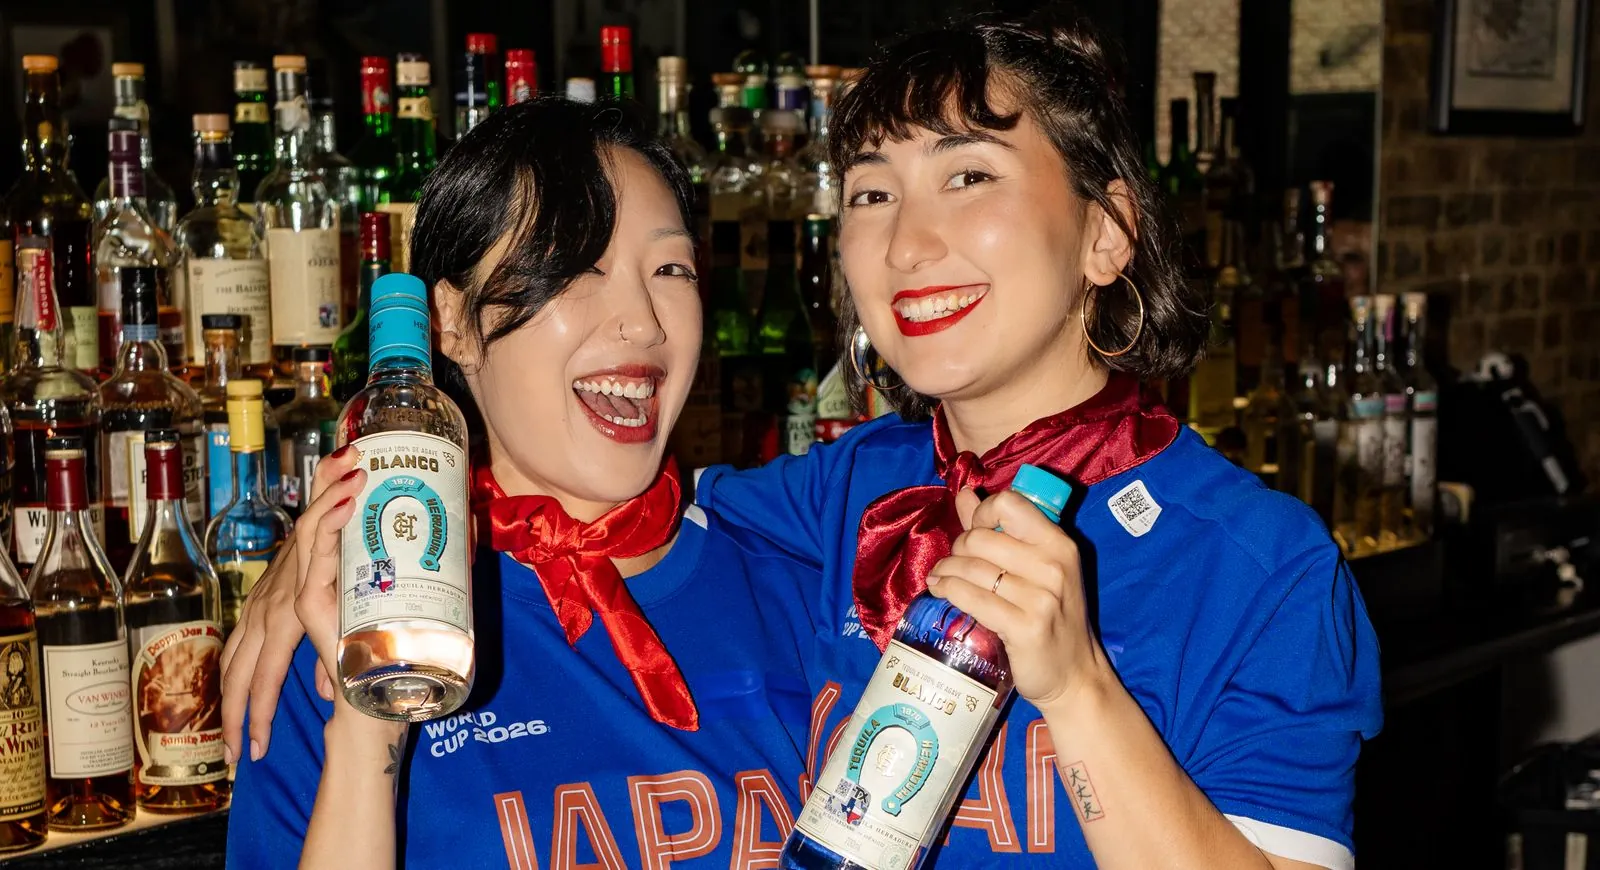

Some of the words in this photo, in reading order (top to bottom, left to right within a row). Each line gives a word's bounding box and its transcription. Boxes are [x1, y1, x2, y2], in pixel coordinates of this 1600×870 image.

[369, 447, 392, 456] TEQUILA
[420, 447, 438, 457] AGAVE
[369, 454, 439, 473] BLANCO
[392, 478, 415, 486] 1870
[365, 503, 381, 554] TEQUILA
[426, 498, 443, 557] HERRADURA
[374, 558, 392, 571] TX
[147, 632, 178, 656] Pappy
[180, 627, 203, 638] Van
[62, 669, 90, 678] Straight
[93, 667, 118, 676] Bourbon
[78, 694, 99, 705] VAN
[892, 672, 957, 716] BLANCO
[12, 710, 24, 720] 10
[901, 706, 921, 721] 1870
[11, 720, 40, 736] RIP
[425, 711, 496, 740] WORLD
[160, 735, 198, 747] Family
[430, 729, 469, 757] CUP
[472, 720, 548, 743] 2026
[849, 719, 881, 771] TEQUILA
[895, 739, 934, 800] HERRADURA
[853, 786, 869, 800] TX
[1070, 768, 1102, 819] 大丈夫
[493, 769, 797, 870] JAPA
